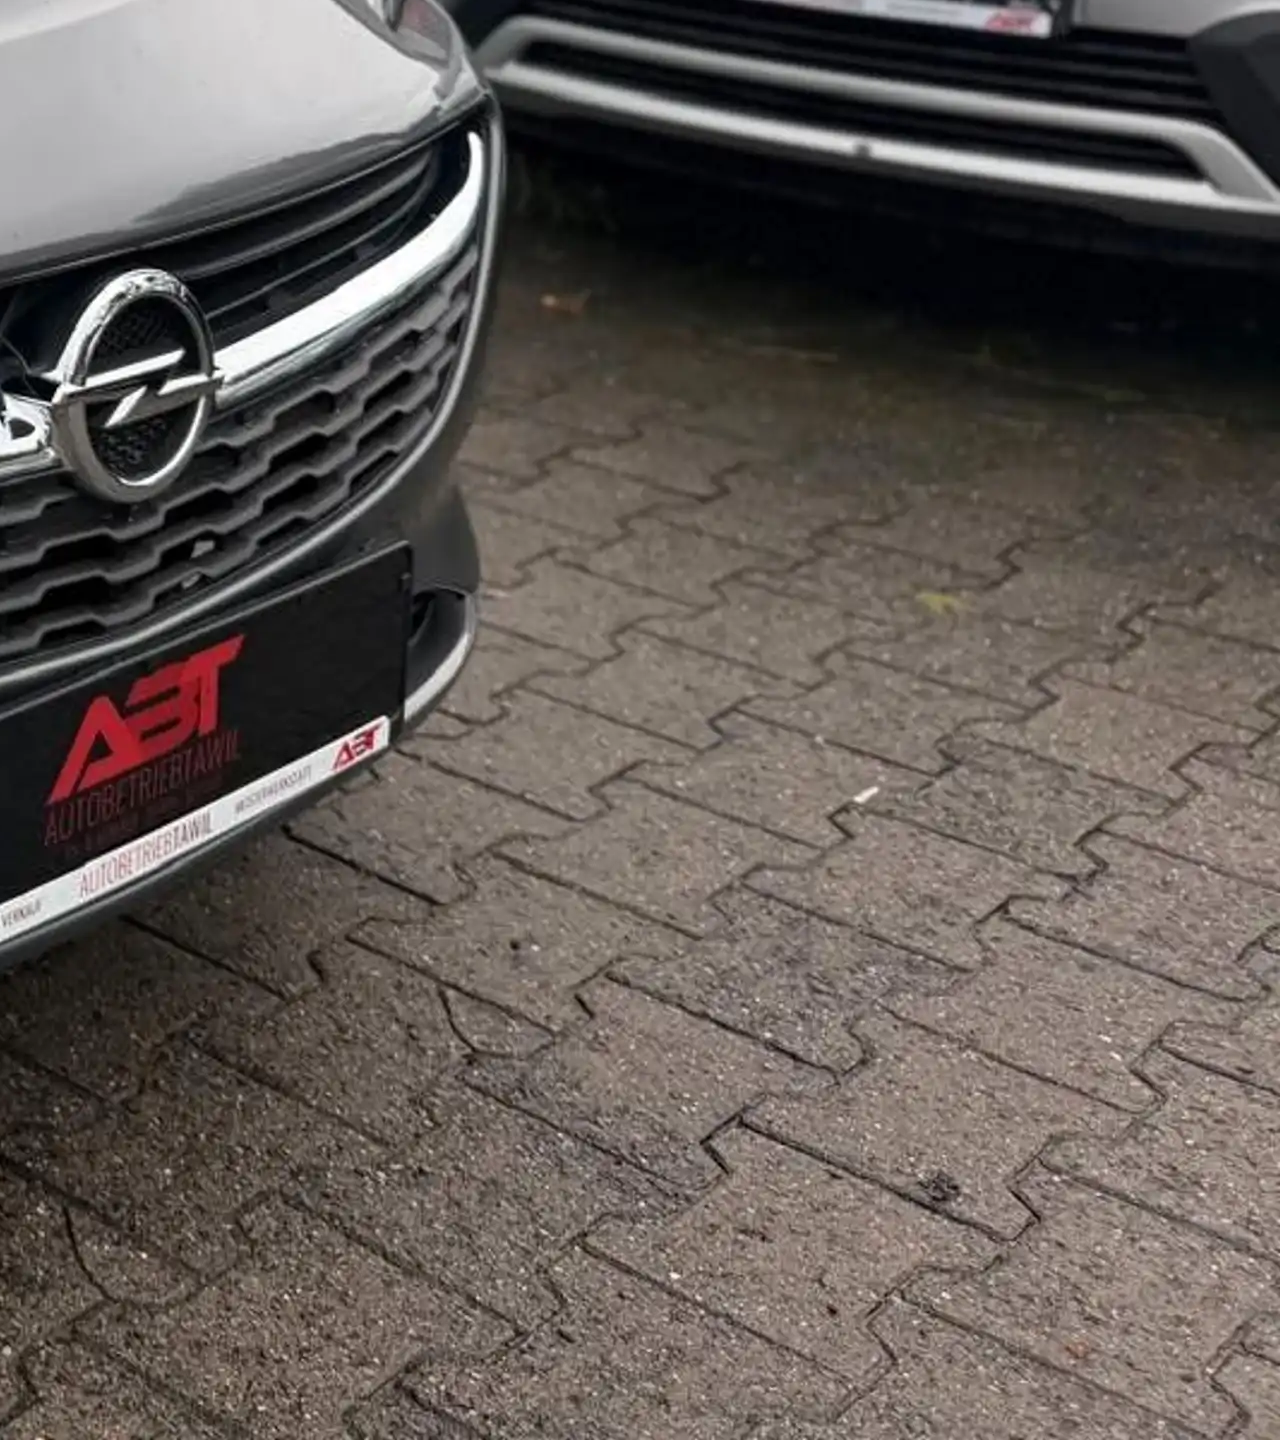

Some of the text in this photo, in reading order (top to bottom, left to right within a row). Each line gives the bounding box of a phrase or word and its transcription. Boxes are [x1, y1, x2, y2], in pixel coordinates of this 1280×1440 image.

[44, 728, 240, 848] AUTOBETRIEBTAWIL
[46, 633, 246, 805] ABT
[79, 812, 213, 899] AUTOBETRIEBTAWIL
[332, 722, 383, 771] ABT
